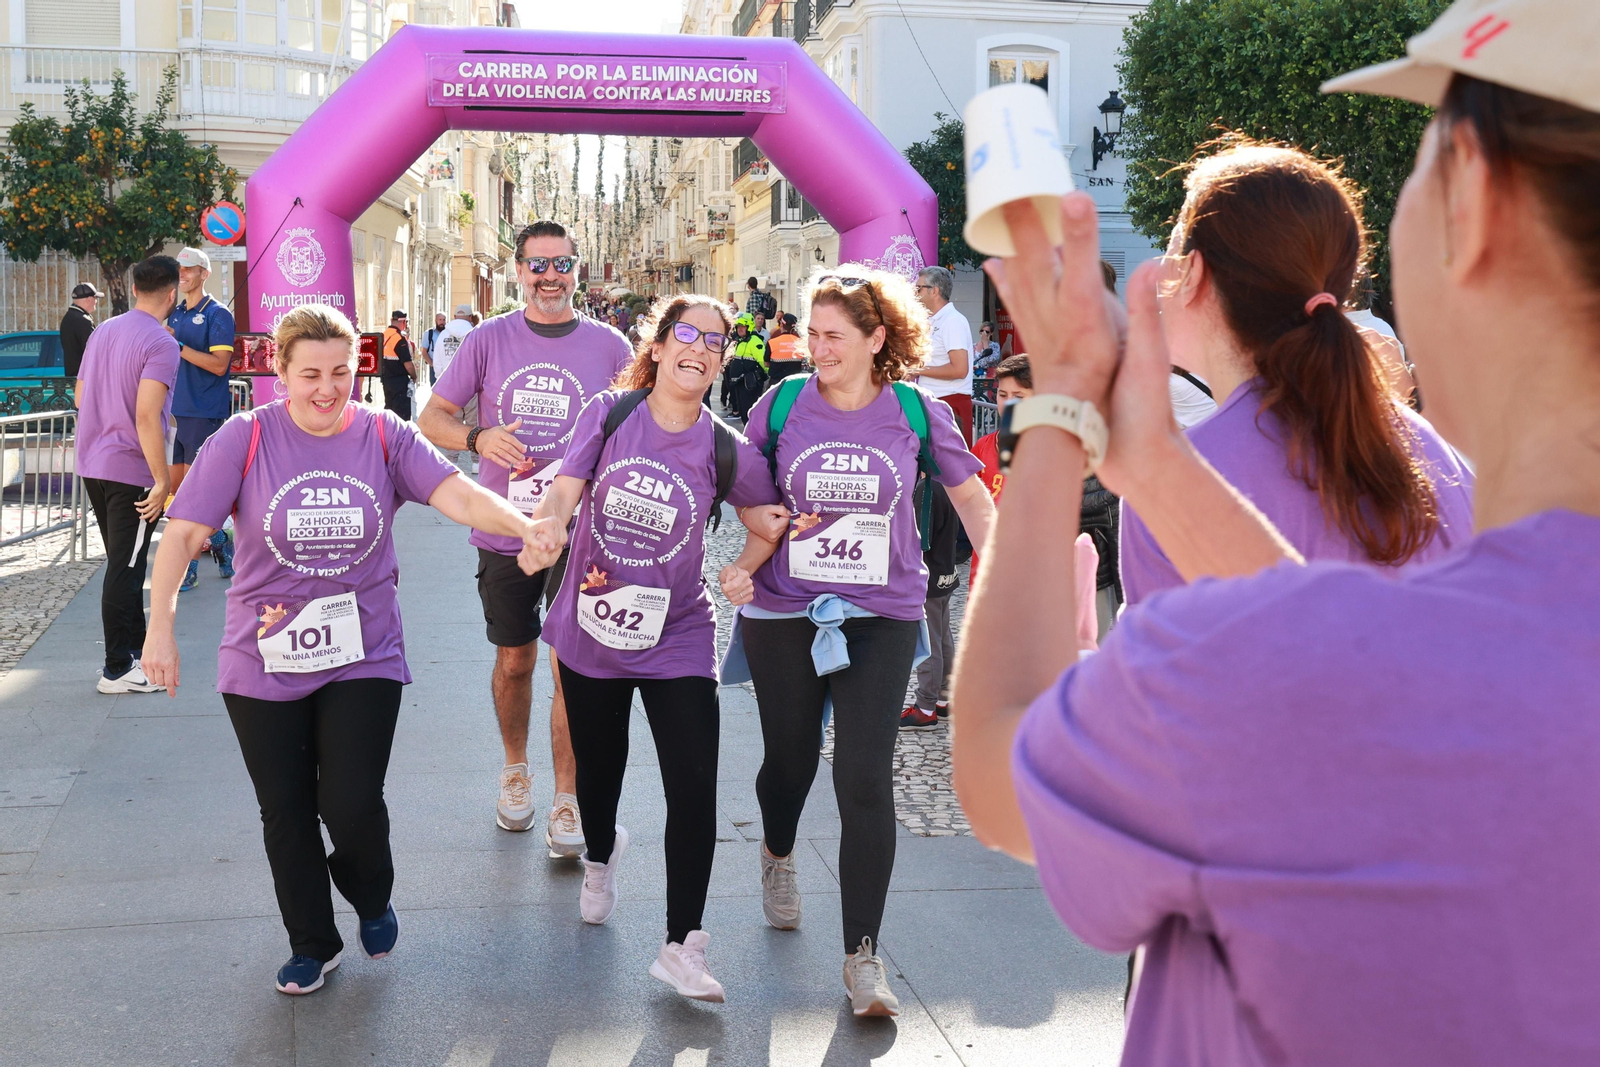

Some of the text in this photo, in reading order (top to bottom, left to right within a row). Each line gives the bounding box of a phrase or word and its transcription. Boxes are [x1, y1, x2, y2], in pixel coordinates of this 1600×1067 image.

[458, 61, 758, 84] CARRERA POR LA ELIMINACIÓN
[442, 83, 772, 104] DE LA VIOLENCIA CONTRA LAS MUJERES
[1089, 177, 1114, 187] SAN
[260, 291, 346, 311] Ayuntamiento
[500, 362, 560, 391] INTERNACIONAL
[525, 374, 564, 393] 25N
[561, 368, 585, 396] CONTRA
[496, 391, 505, 406] DÍA
[521, 396, 560, 407] 24 HORAS
[514, 404, 564, 417] 900 21 21 30
[529, 442, 556, 452] HACIA
[599, 456, 671, 482] INTERNACIONAL
[784, 473, 794, 490] DÍA
[789, 441, 863, 472] INTERNACIONAL
[865, 446, 898, 475] CONTRA
[894, 474, 903, 489] LA
[820, 452, 869, 473] 25N
[268, 469, 341, 511] INTERNACIONAL
[343, 474, 377, 503] CONTRA
[591, 481, 600, 498] DÍA
[624, 470, 674, 503] 25N
[671, 473, 697, 511] CONTRA
[817, 480, 867, 491] 24 HORAS
[299, 487, 351, 506] 25N
[611, 488, 634, 501] SERVICIO
[639, 498, 675, 515] EMERGENCIAS
[809, 490, 874, 501] 900 21 21 30
[373, 501, 382, 517] LA
[605, 504, 668, 530] 900 21 21 30
[615, 497, 664, 520] 24 HORAS
[689, 511, 698, 525] LA
[822, 505, 852, 513] Ayuntamiento
[263, 512, 274, 531] DÍA
[298, 516, 352, 526] 24 HORAS
[614, 523, 643, 537] Ayuntamiento
[856, 520, 887, 529] CARRERA
[291, 526, 360, 538] 900 21 21 30
[353, 517, 384, 565] VIOLENCIA
[656, 526, 694, 564] VIOLENCIA
[814, 537, 864, 561] 346
[603, 548, 621, 564] LAS
[622, 557, 654, 567] HACIA
[809, 560, 867, 571] NI UNA MENOS
[296, 564, 315, 576] LAS
[317, 564, 350, 577] HACIA
[321, 599, 353, 611] CARRERA
[636, 593, 666, 602] CARRERA
[594, 599, 645, 631] 042
[581, 609, 655, 641] TU LUCHA ES MI LUCHA
[287, 624, 332, 652] 101
[282, 645, 342, 661] NI UNA MENOS
